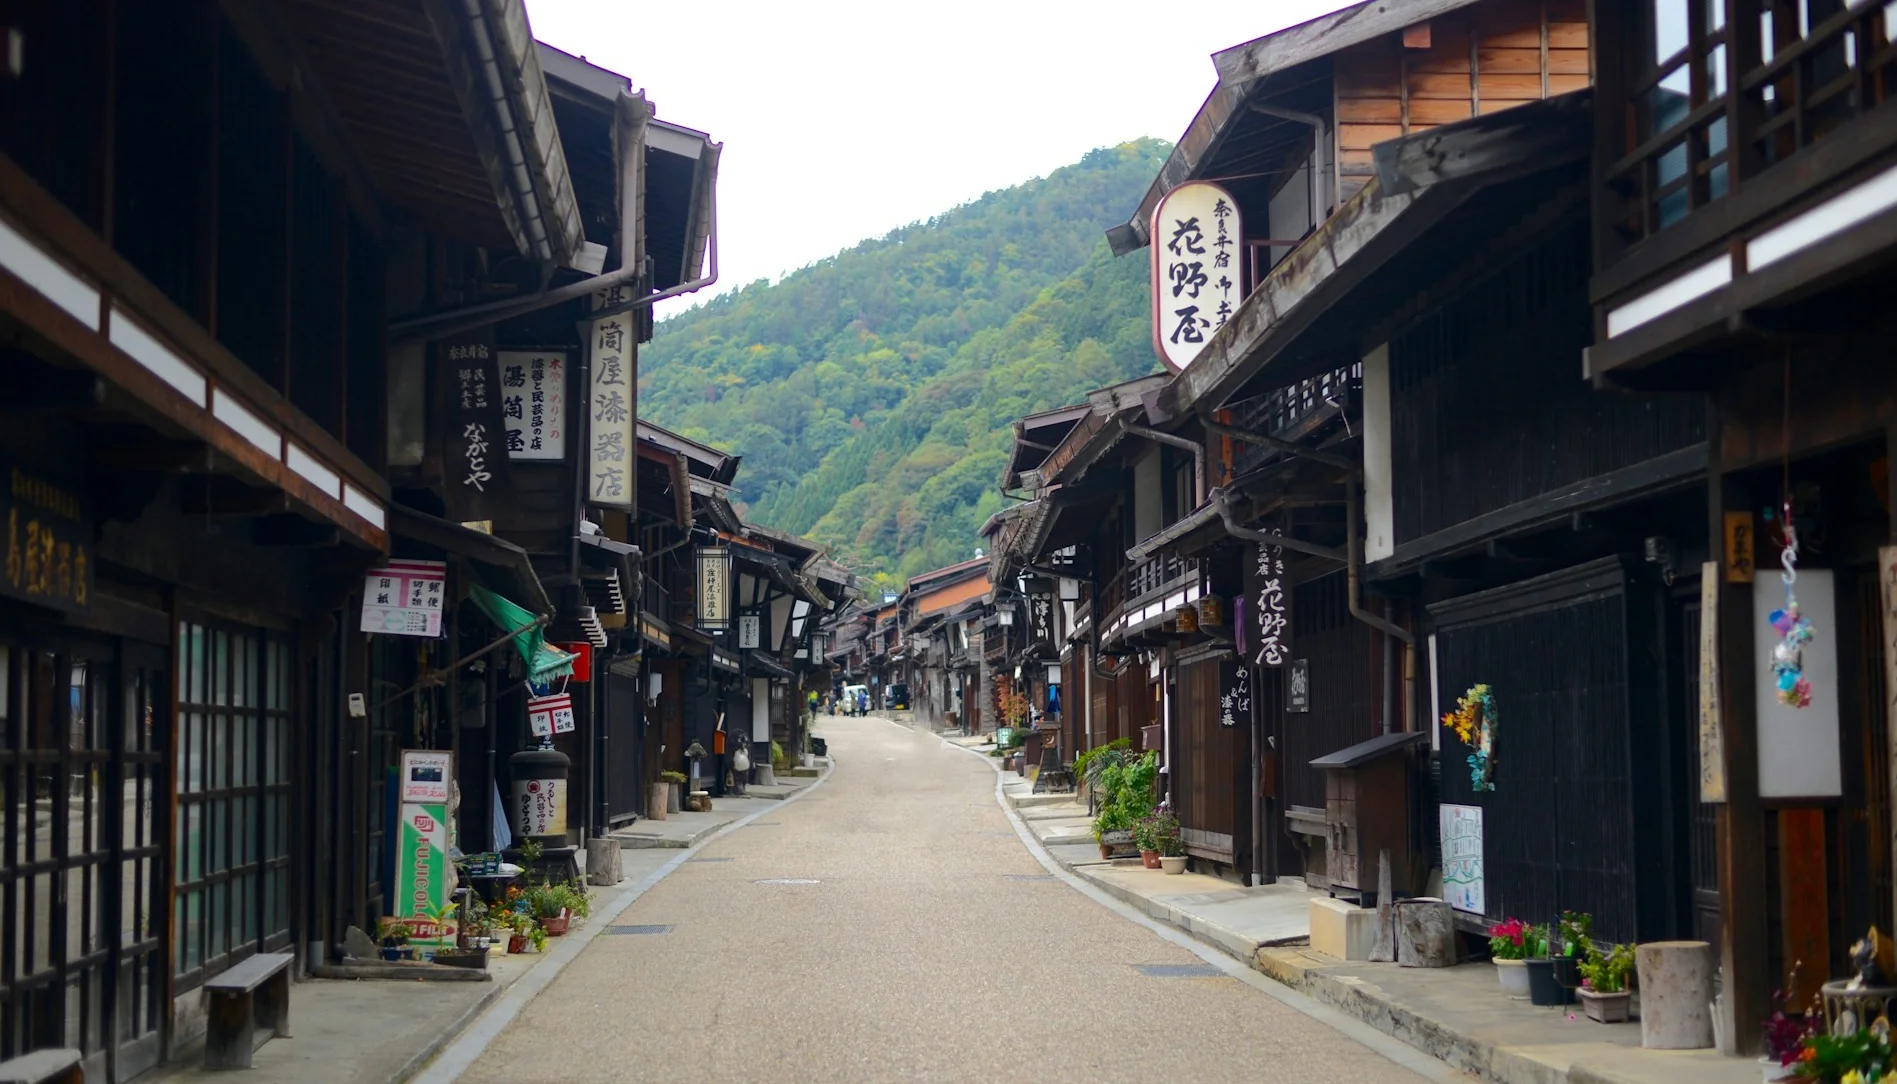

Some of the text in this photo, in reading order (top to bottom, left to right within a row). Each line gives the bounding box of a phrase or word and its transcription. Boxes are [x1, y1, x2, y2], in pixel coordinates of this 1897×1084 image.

[1213, 198, 1233, 268] 奈良井宿
[1167, 217, 1210, 344] 花野屋
[503, 364, 527, 452] 湯筒屋
[463, 422, 492, 492] ながとや
[377, 578, 391, 604] 印紙
[412, 581, 424, 607] 切手類
[428, 582, 441, 607] 郵便
[1255, 578, 1289, 665] 花野屋
